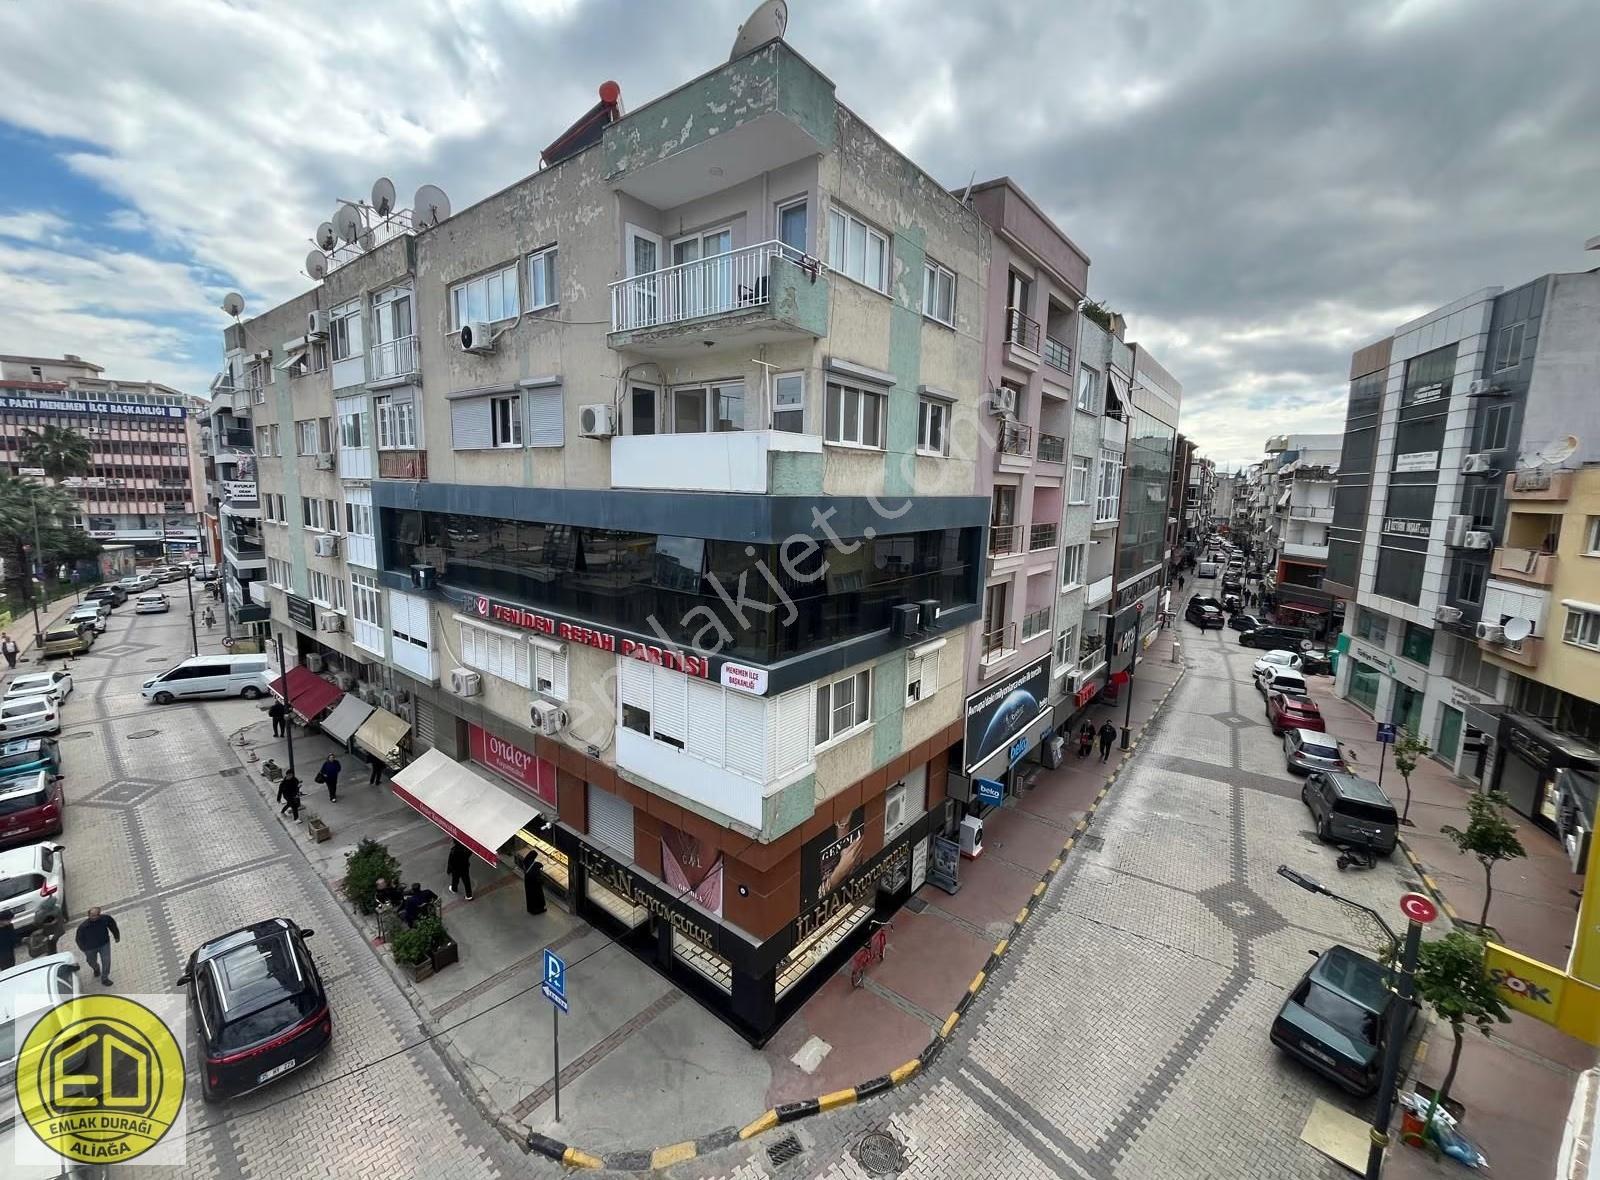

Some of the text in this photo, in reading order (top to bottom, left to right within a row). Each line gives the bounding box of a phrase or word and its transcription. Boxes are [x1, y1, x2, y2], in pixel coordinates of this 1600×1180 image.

[9, 399, 37, 409] PARTİ
[39, 401, 86, 411] MENEMEN
[493, 604, 709, 679] YENİDEN REFAH PARTİSİ
[980, 784, 1000, 797] beko
